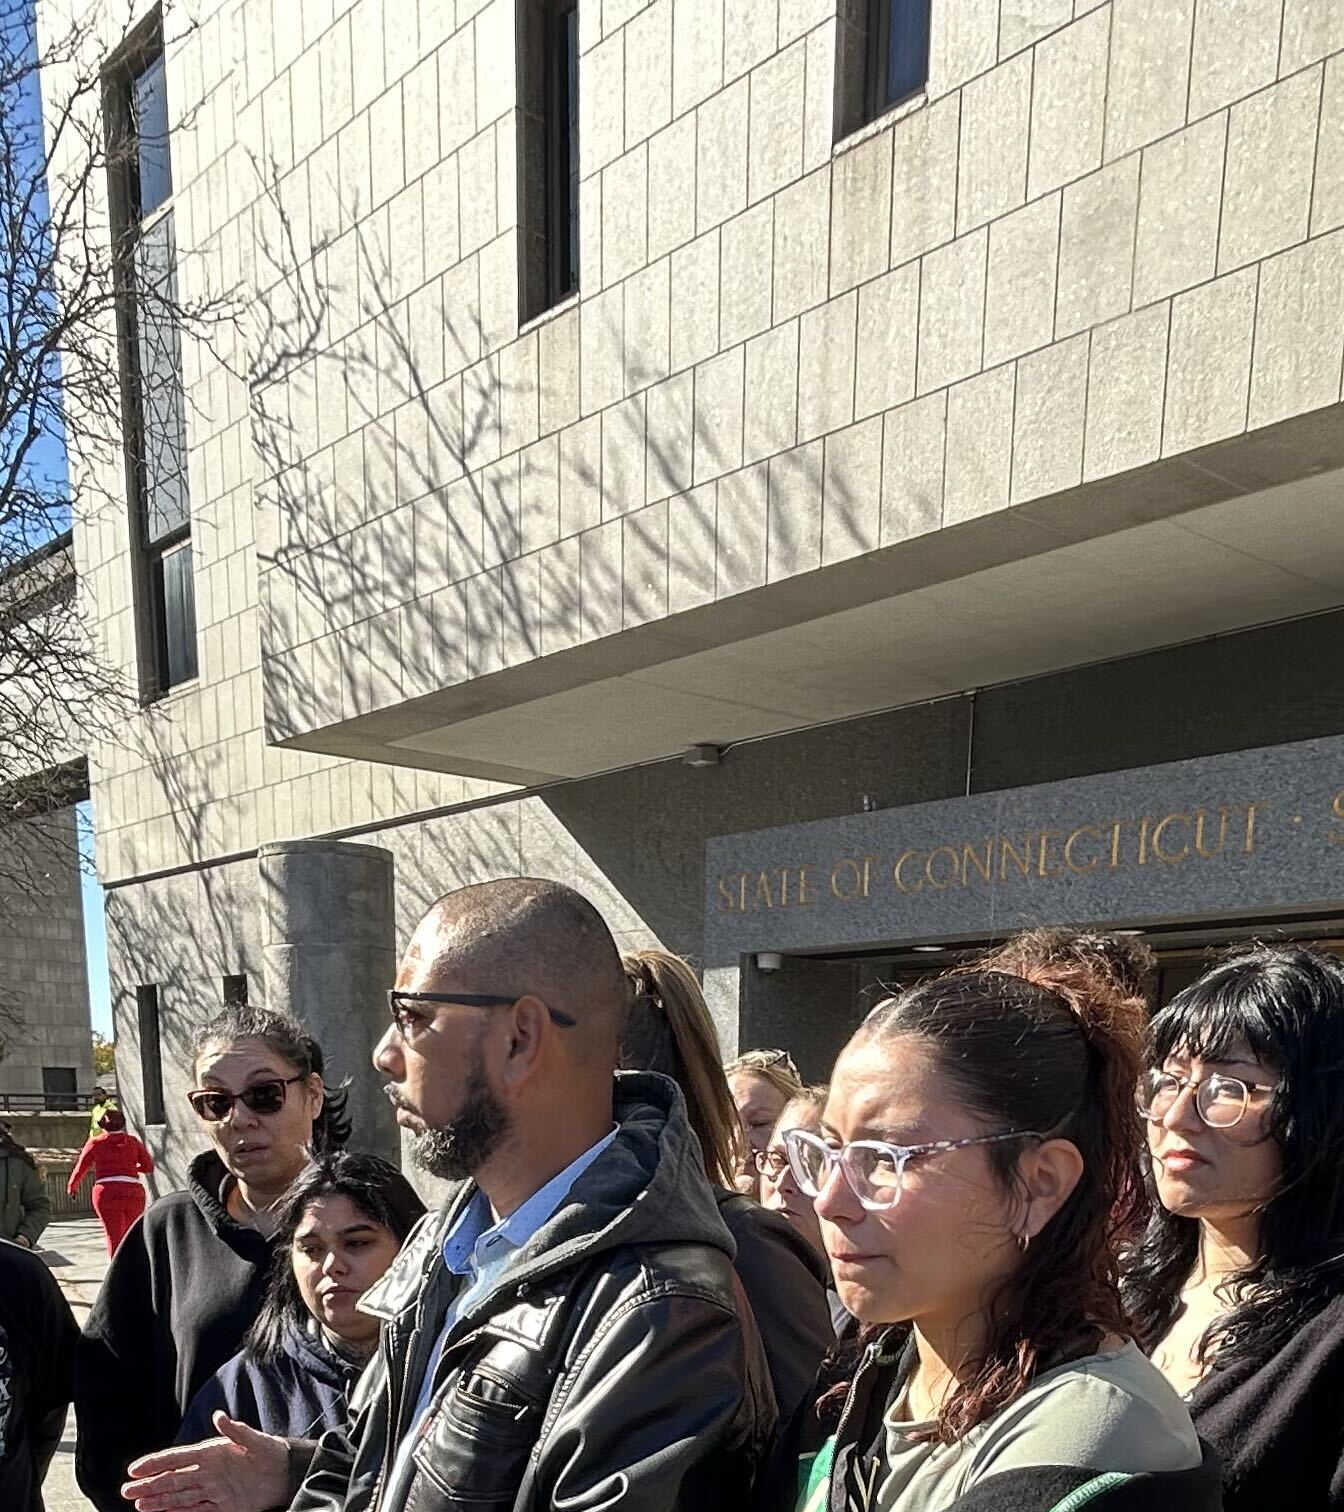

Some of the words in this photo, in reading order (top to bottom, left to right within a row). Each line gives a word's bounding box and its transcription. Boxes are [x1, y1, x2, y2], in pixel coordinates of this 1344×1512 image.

[717, 863, 814, 913] STATE
[830, 854, 880, 899] OF
[893, 803, 1267, 895] CONNECTICUT
